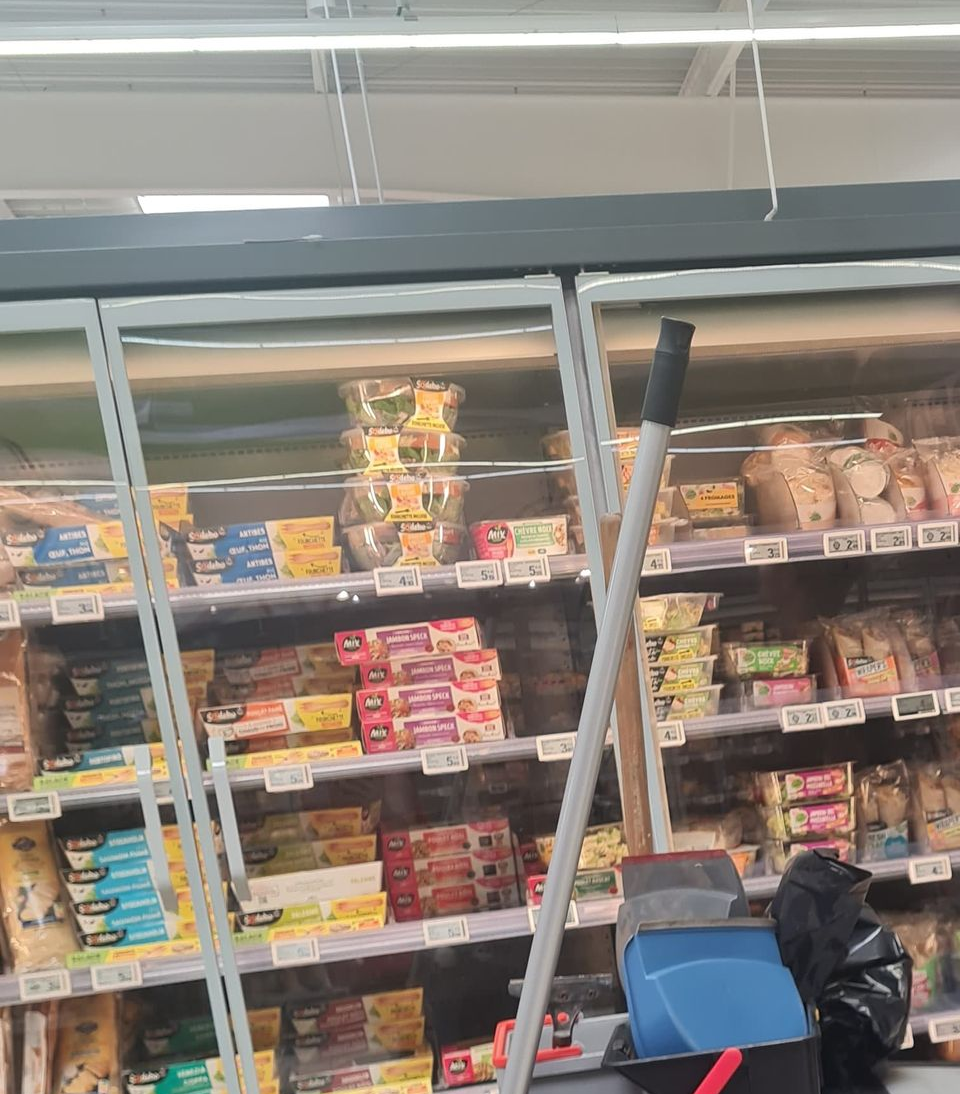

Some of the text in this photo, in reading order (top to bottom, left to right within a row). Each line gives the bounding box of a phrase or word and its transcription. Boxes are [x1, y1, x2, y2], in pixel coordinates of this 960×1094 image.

[386, 632, 428, 645] JAMBON SPECK
[411, 663, 452, 676] JAMBON SPECK
[408, 692, 449, 703] JAMBON SPECK
[413, 722, 455, 734] JAMBON SPECK
